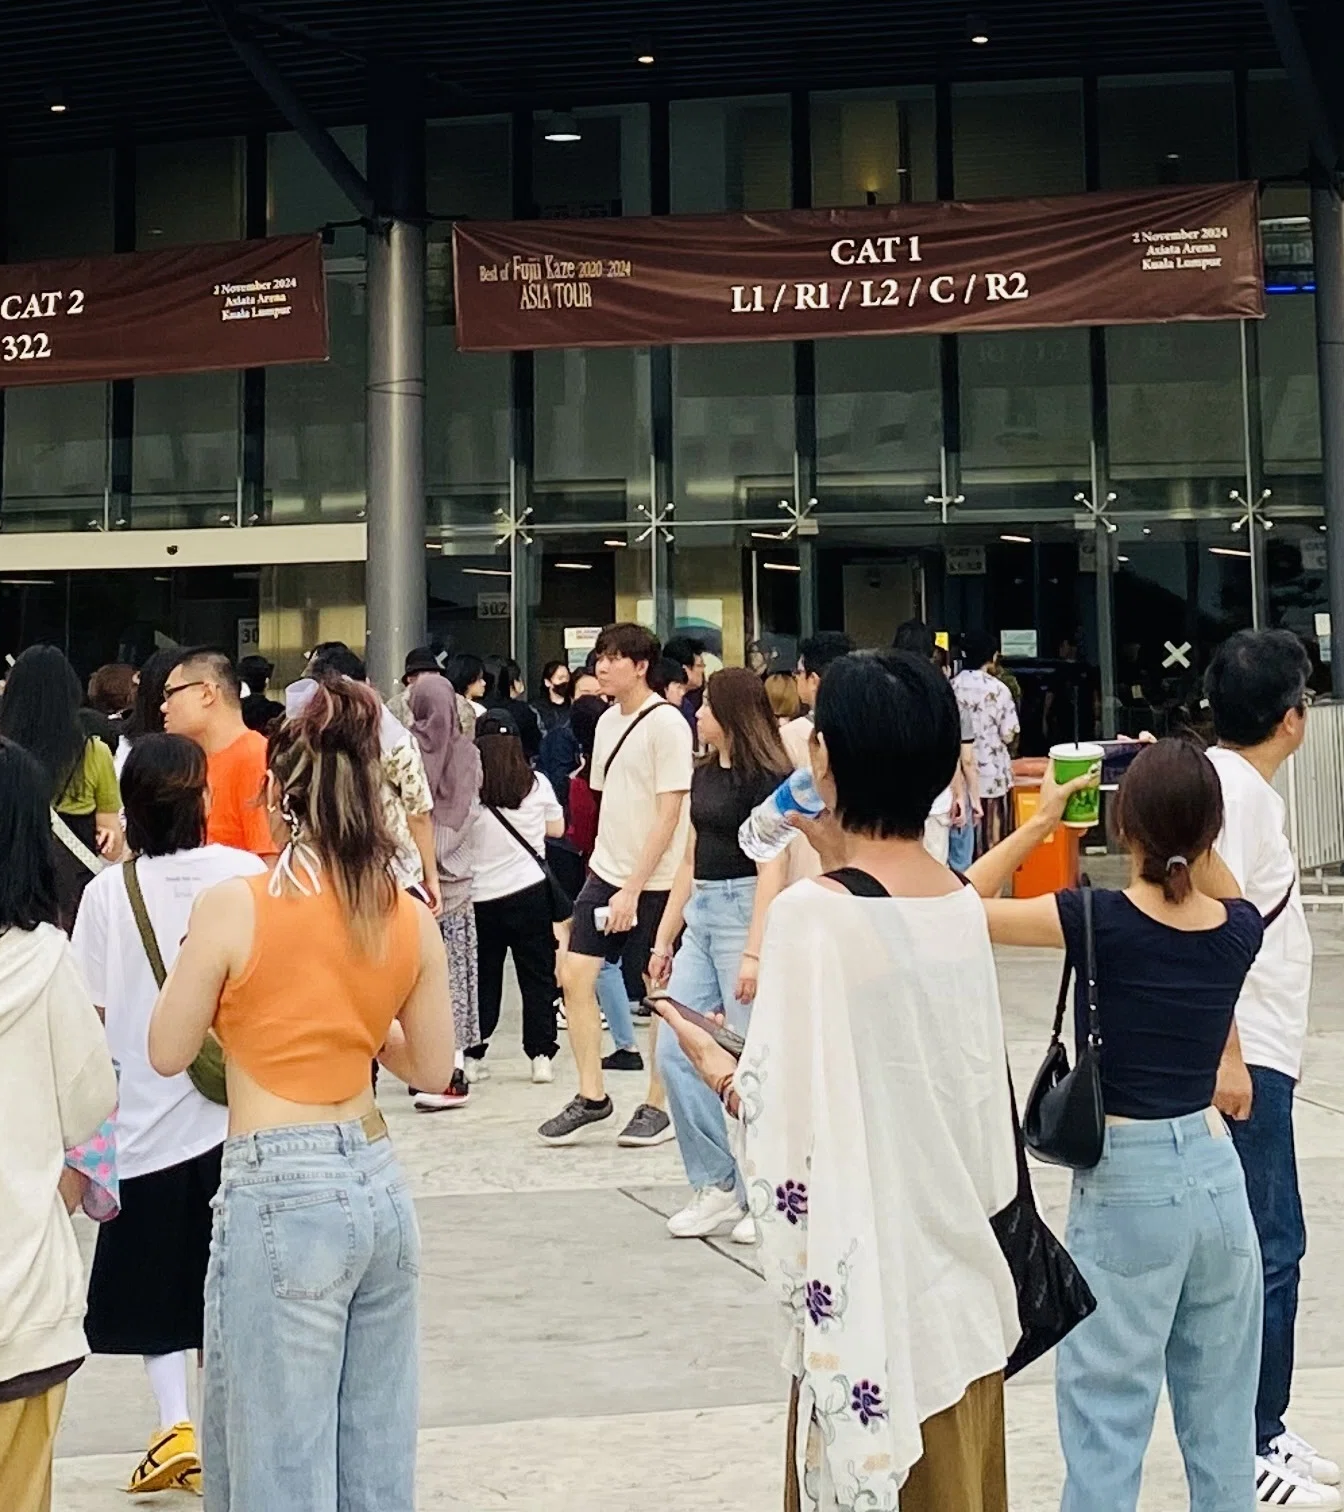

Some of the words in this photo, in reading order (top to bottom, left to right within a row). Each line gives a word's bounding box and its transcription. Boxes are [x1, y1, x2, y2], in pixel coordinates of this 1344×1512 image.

[831, 237, 900, 265] CAT
[909, 236, 922, 261] 1
[545, 255, 575, 279] Kaze
[0, 291, 62, 320] CAT
[67, 289, 85, 315] 2
[520, 284, 551, 309] ASIA
[555, 282, 592, 308] TOUR
[731, 286, 764, 313] L1
[773, 284, 786, 313] /
[794, 282, 830, 310] R1
[839, 281, 852, 310] /
[860, 279, 899, 307] L2
[908, 277, 922, 307] /
[930, 276, 954, 303] C
[964, 274, 976, 304] /
[985, 272, 1029, 301] R2
[2, 332, 51, 361] 322
[242, 628, 259, 643] 30
